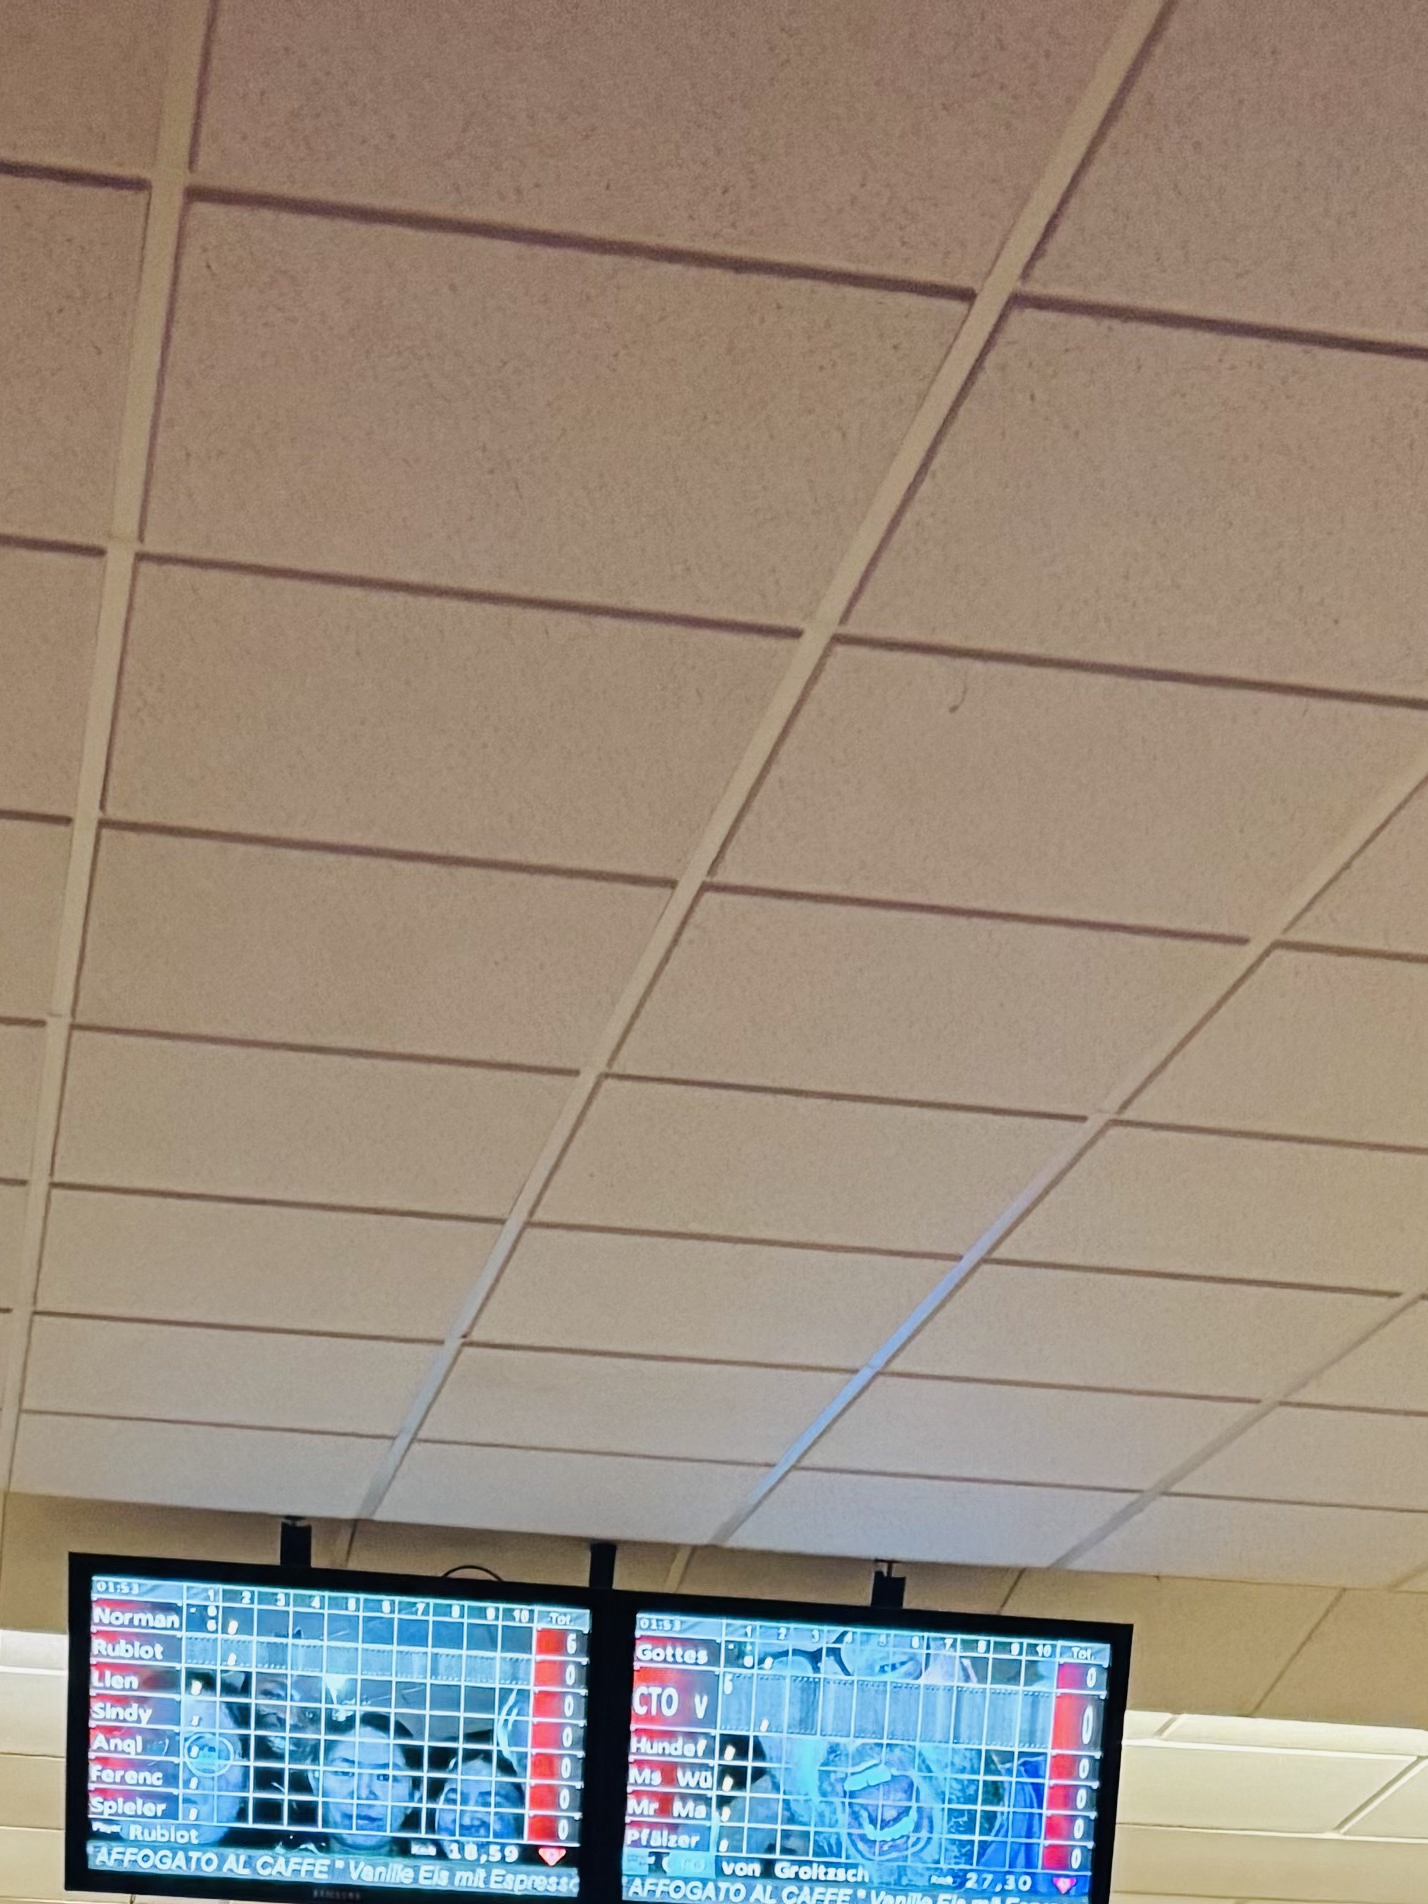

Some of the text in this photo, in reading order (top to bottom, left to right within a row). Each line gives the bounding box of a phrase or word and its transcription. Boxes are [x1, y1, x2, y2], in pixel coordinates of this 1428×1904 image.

[93, 1607, 577, 1654] Norman 6
[636, 1643, 709, 1664] Gottes
[94, 1669, 139, 1690] Lien
[634, 1685, 679, 1718] CTO
[92, 1702, 152, 1725] Sindy
[92, 1765, 163, 1786] Ferenc
[630, 1767, 661, 1786] Ms
[90, 1797, 166, 1818] Spieler
[627, 1799, 706, 1818] Mr Ma
[223, 1855, 251, 1876] AL
[256, 1855, 331, 1880] CAFFE
[349, 1860, 413, 1885] Vanille
[419, 1865, 450, 1887] Eis
[455, 1867, 487, 1889] mit
[722, 1860, 761, 1878] von
[751, 1883, 778, 1904] AL
